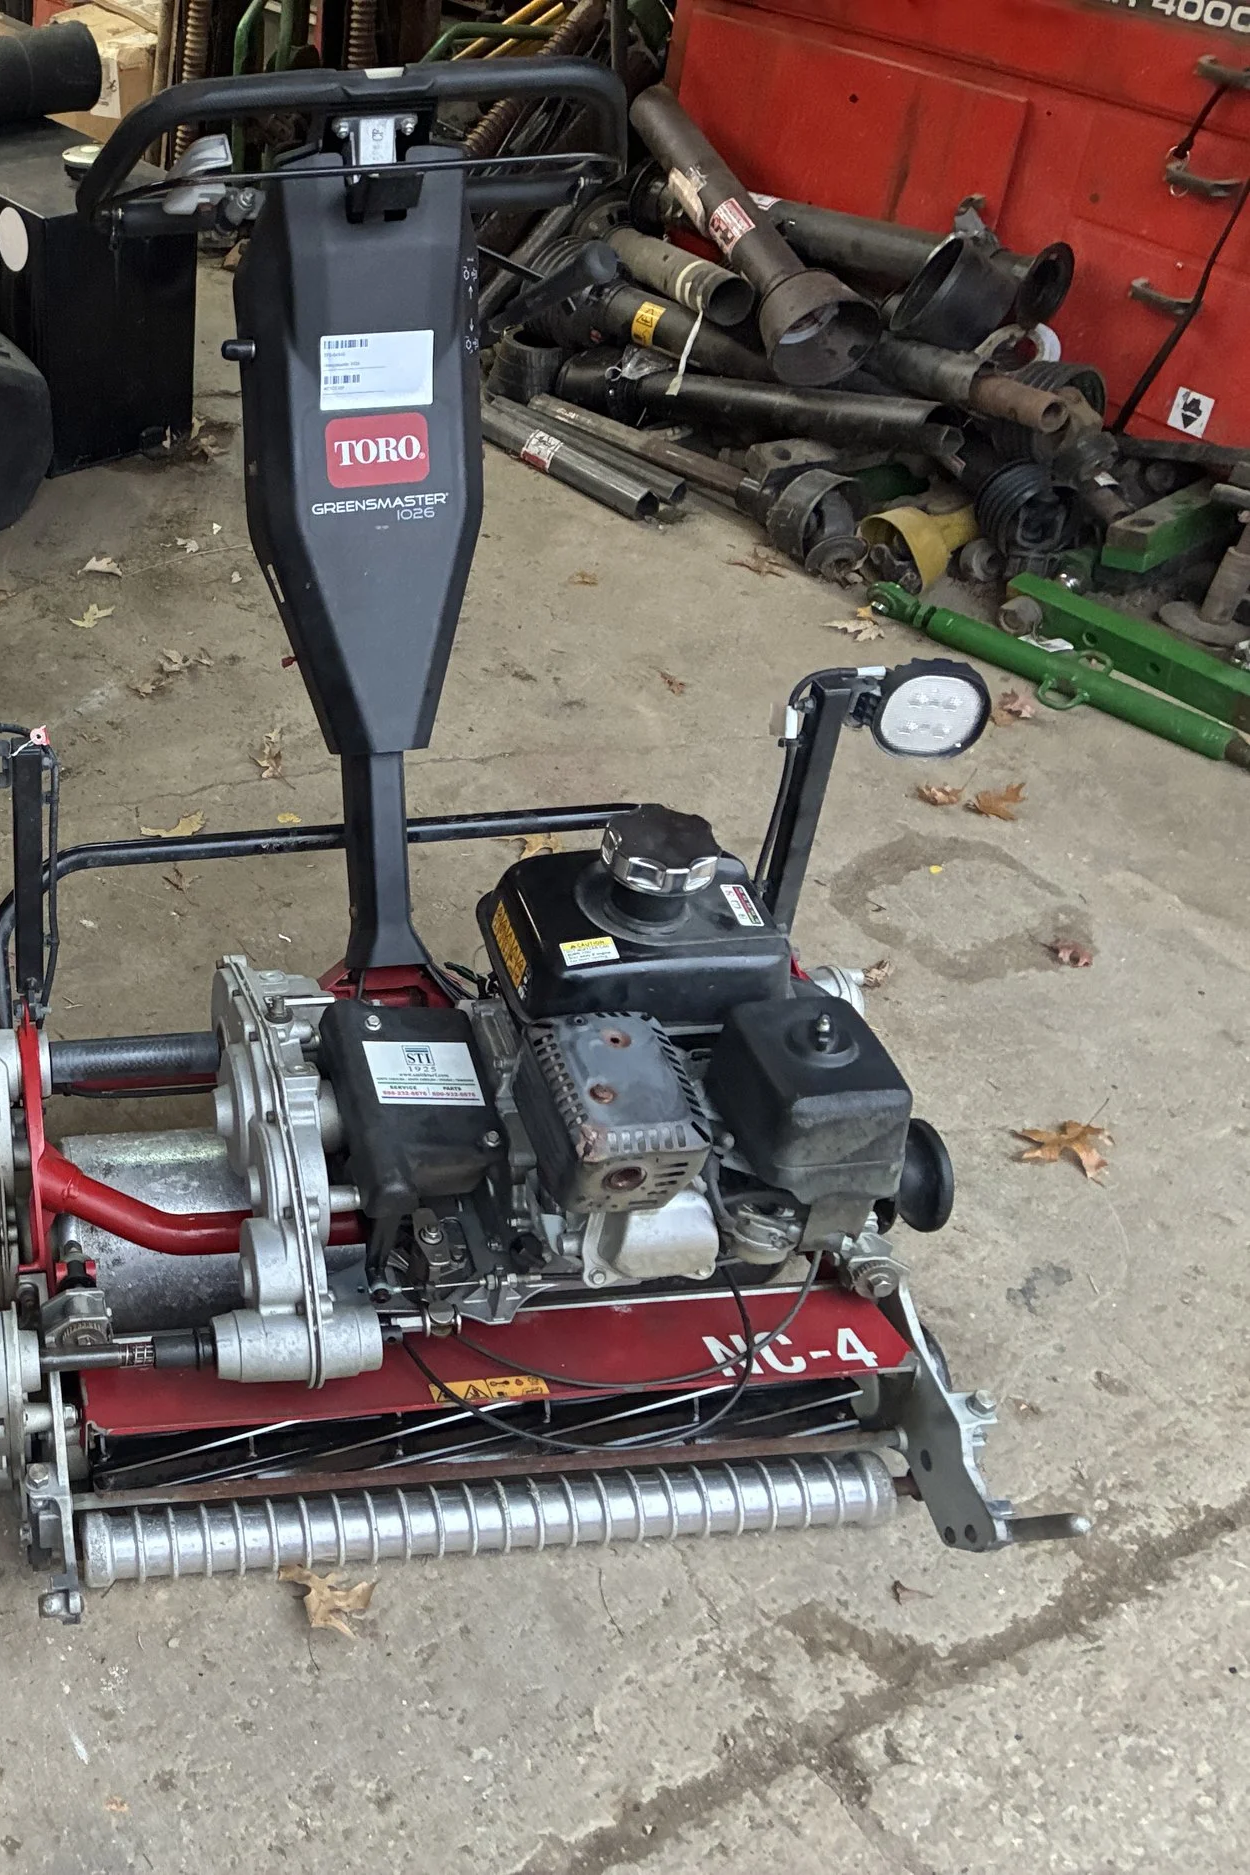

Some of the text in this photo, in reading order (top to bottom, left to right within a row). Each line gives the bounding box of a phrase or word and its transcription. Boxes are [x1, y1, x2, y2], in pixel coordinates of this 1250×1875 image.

[333, 434, 421, 467] TORO
[311, 492, 449, 516] GREENSMASTER
[396, 506, 435, 521] 1026
[406, 1053, 432, 1064] STI
[702, 1327, 879, 1377] NC-4
